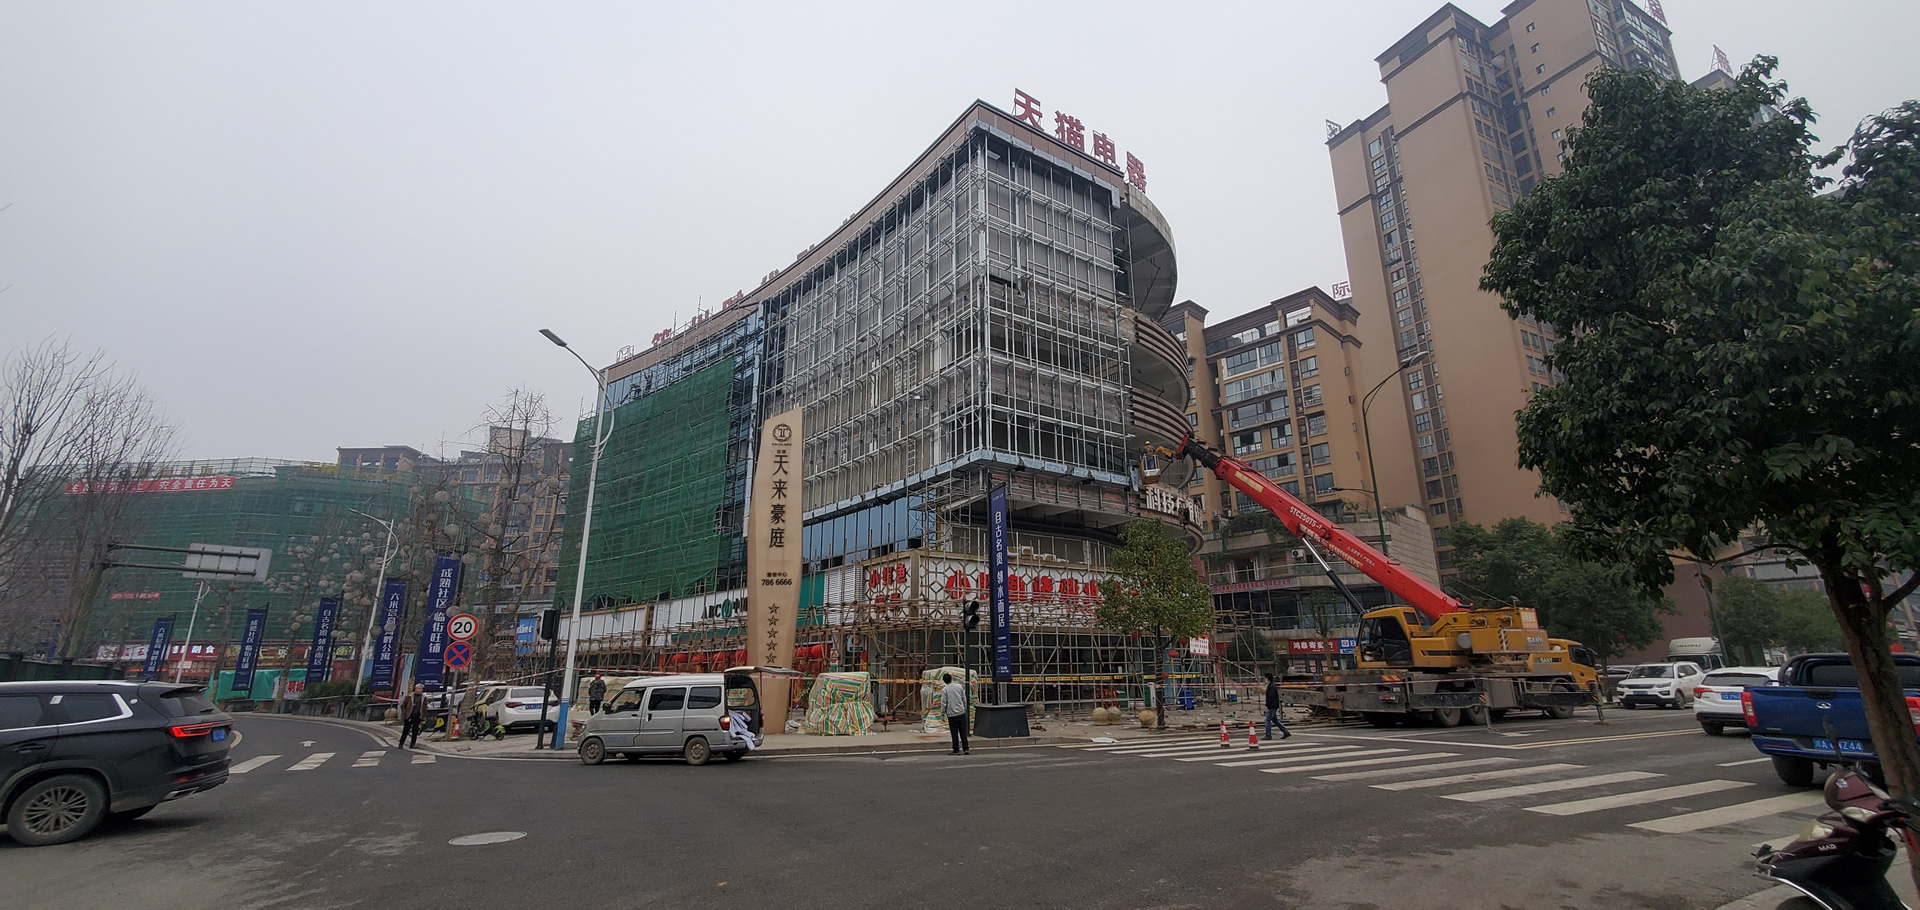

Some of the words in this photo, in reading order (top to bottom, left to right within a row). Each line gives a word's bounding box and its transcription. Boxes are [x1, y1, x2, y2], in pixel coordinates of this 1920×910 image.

[1012, 88, 1147, 194] 天猫电器
[769, 454, 789, 548] 天来豪庭
[436, 567, 454, 609] 成熟社区
[761, 578, 775, 586] 786
[775, 578, 793, 586] 6666
[428, 611, 446, 653] 临街旺铺
[453, 621, 473, 634] 20
[701, 603, 722, 619] ABC
